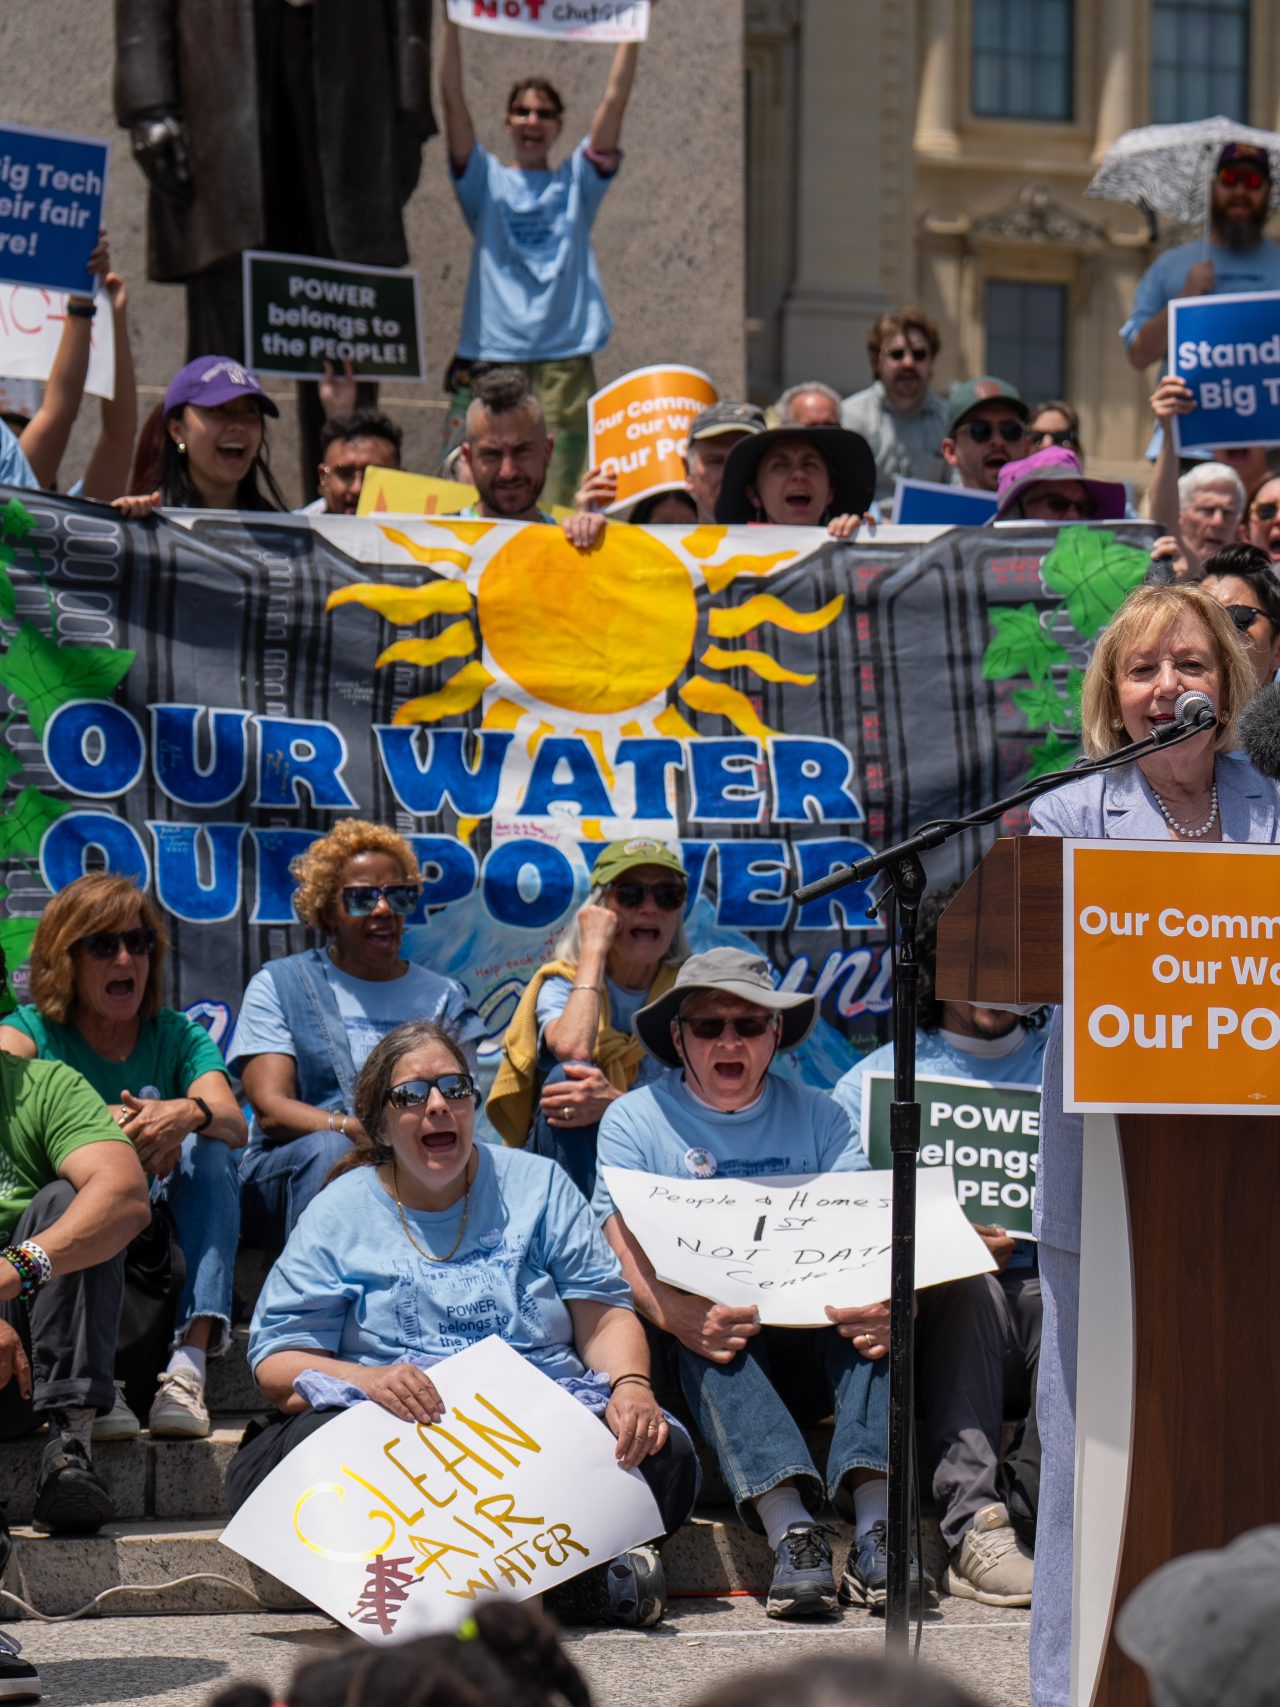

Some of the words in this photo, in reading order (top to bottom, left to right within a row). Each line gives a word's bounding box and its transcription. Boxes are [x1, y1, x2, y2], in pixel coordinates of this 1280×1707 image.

[36, 163, 101, 196] Tech
[40, 198, 90, 229] fair
[288, 275, 377, 309] POWER
[267, 302, 368, 339] belongs
[371, 315, 400, 338] to
[261, 332, 306, 358] the
[309, 335, 407, 365] PEOPLE!
[1201, 379, 1257, 416] Big
[594, 409, 625, 436] Our
[626, 417, 664, 440] Our
[43, 699, 358, 810] OUR
[372, 724, 866, 824] WATER
[1079, 905, 1150, 936] Our
[1152, 954, 1222, 985] Our
[1087, 1004, 1193, 1049] Our
[649, 1186, 736, 1209] People
[957, 1180, 1036, 1212] PEO
[677, 1237, 770, 1261] NOT
[438, 1316, 492, 1336] belongs
[495, 1314, 510, 1326] to
[446, 1299, 498, 1319] POWER
[439, 1336, 463, 1347] the
[293, 1392, 541, 1564] CLEAN
[408, 1494, 544, 1579] AIR
[445, 1523, 590, 1600] WATER
